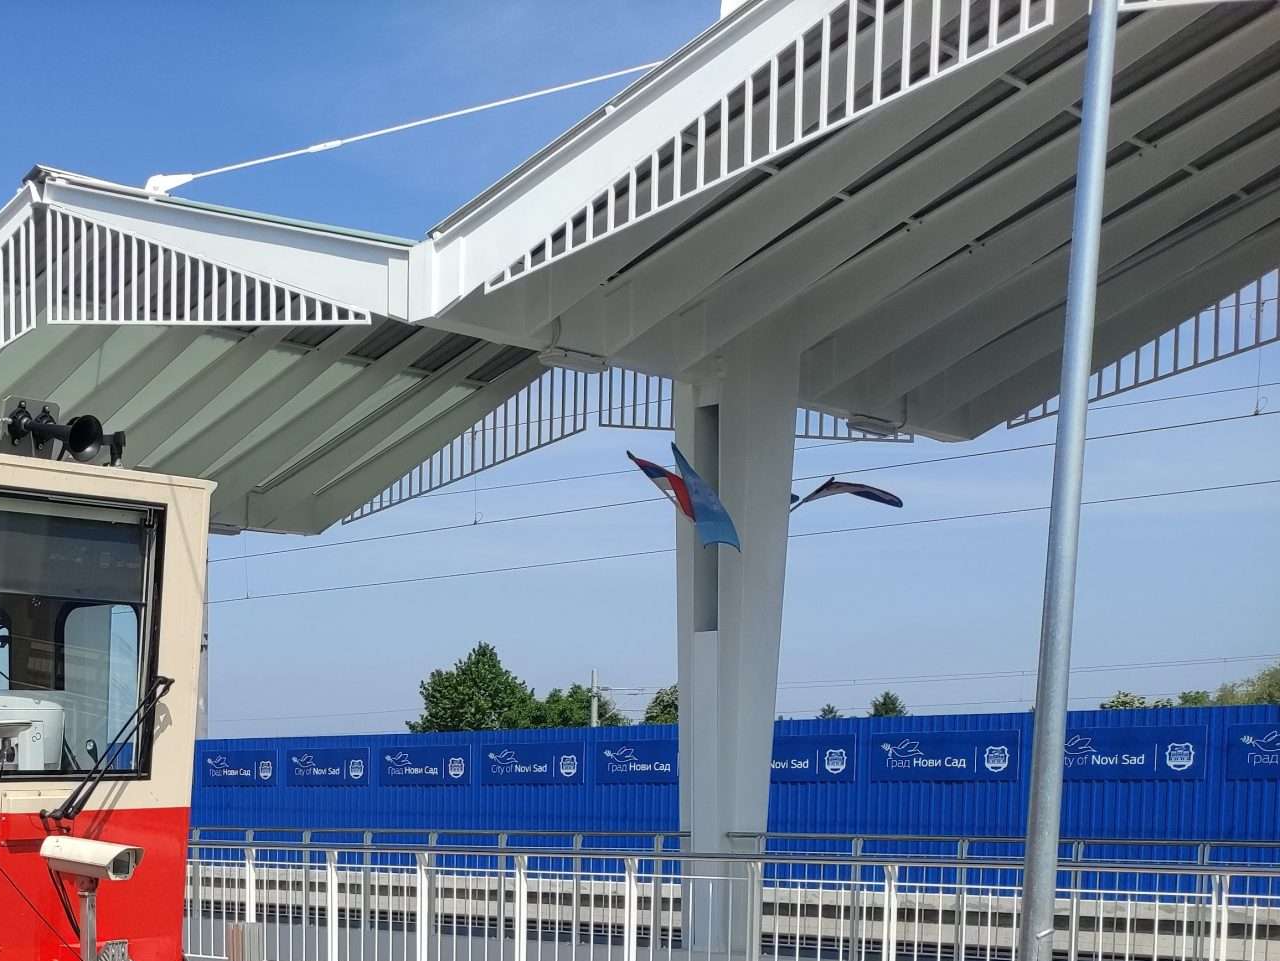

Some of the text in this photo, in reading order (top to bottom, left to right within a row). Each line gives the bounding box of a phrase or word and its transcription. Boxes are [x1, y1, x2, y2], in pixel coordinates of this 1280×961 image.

[790, 758, 809, 769] Sad
[913, 758, 942, 768] Нови
[945, 757, 966, 768] Сад
[1091, 754, 1118, 765] Novi
[1122, 754, 1145, 765] Sad
[328, 766, 340, 775] Sad
[405, 766, 423, 775] Нови
[424, 766, 439, 777] Сад
[515, 764, 532, 774] Novi
[533, 763, 548, 773] Sad
[629, 762, 652, 772] Нови
[653, 762, 671, 773] Сад
